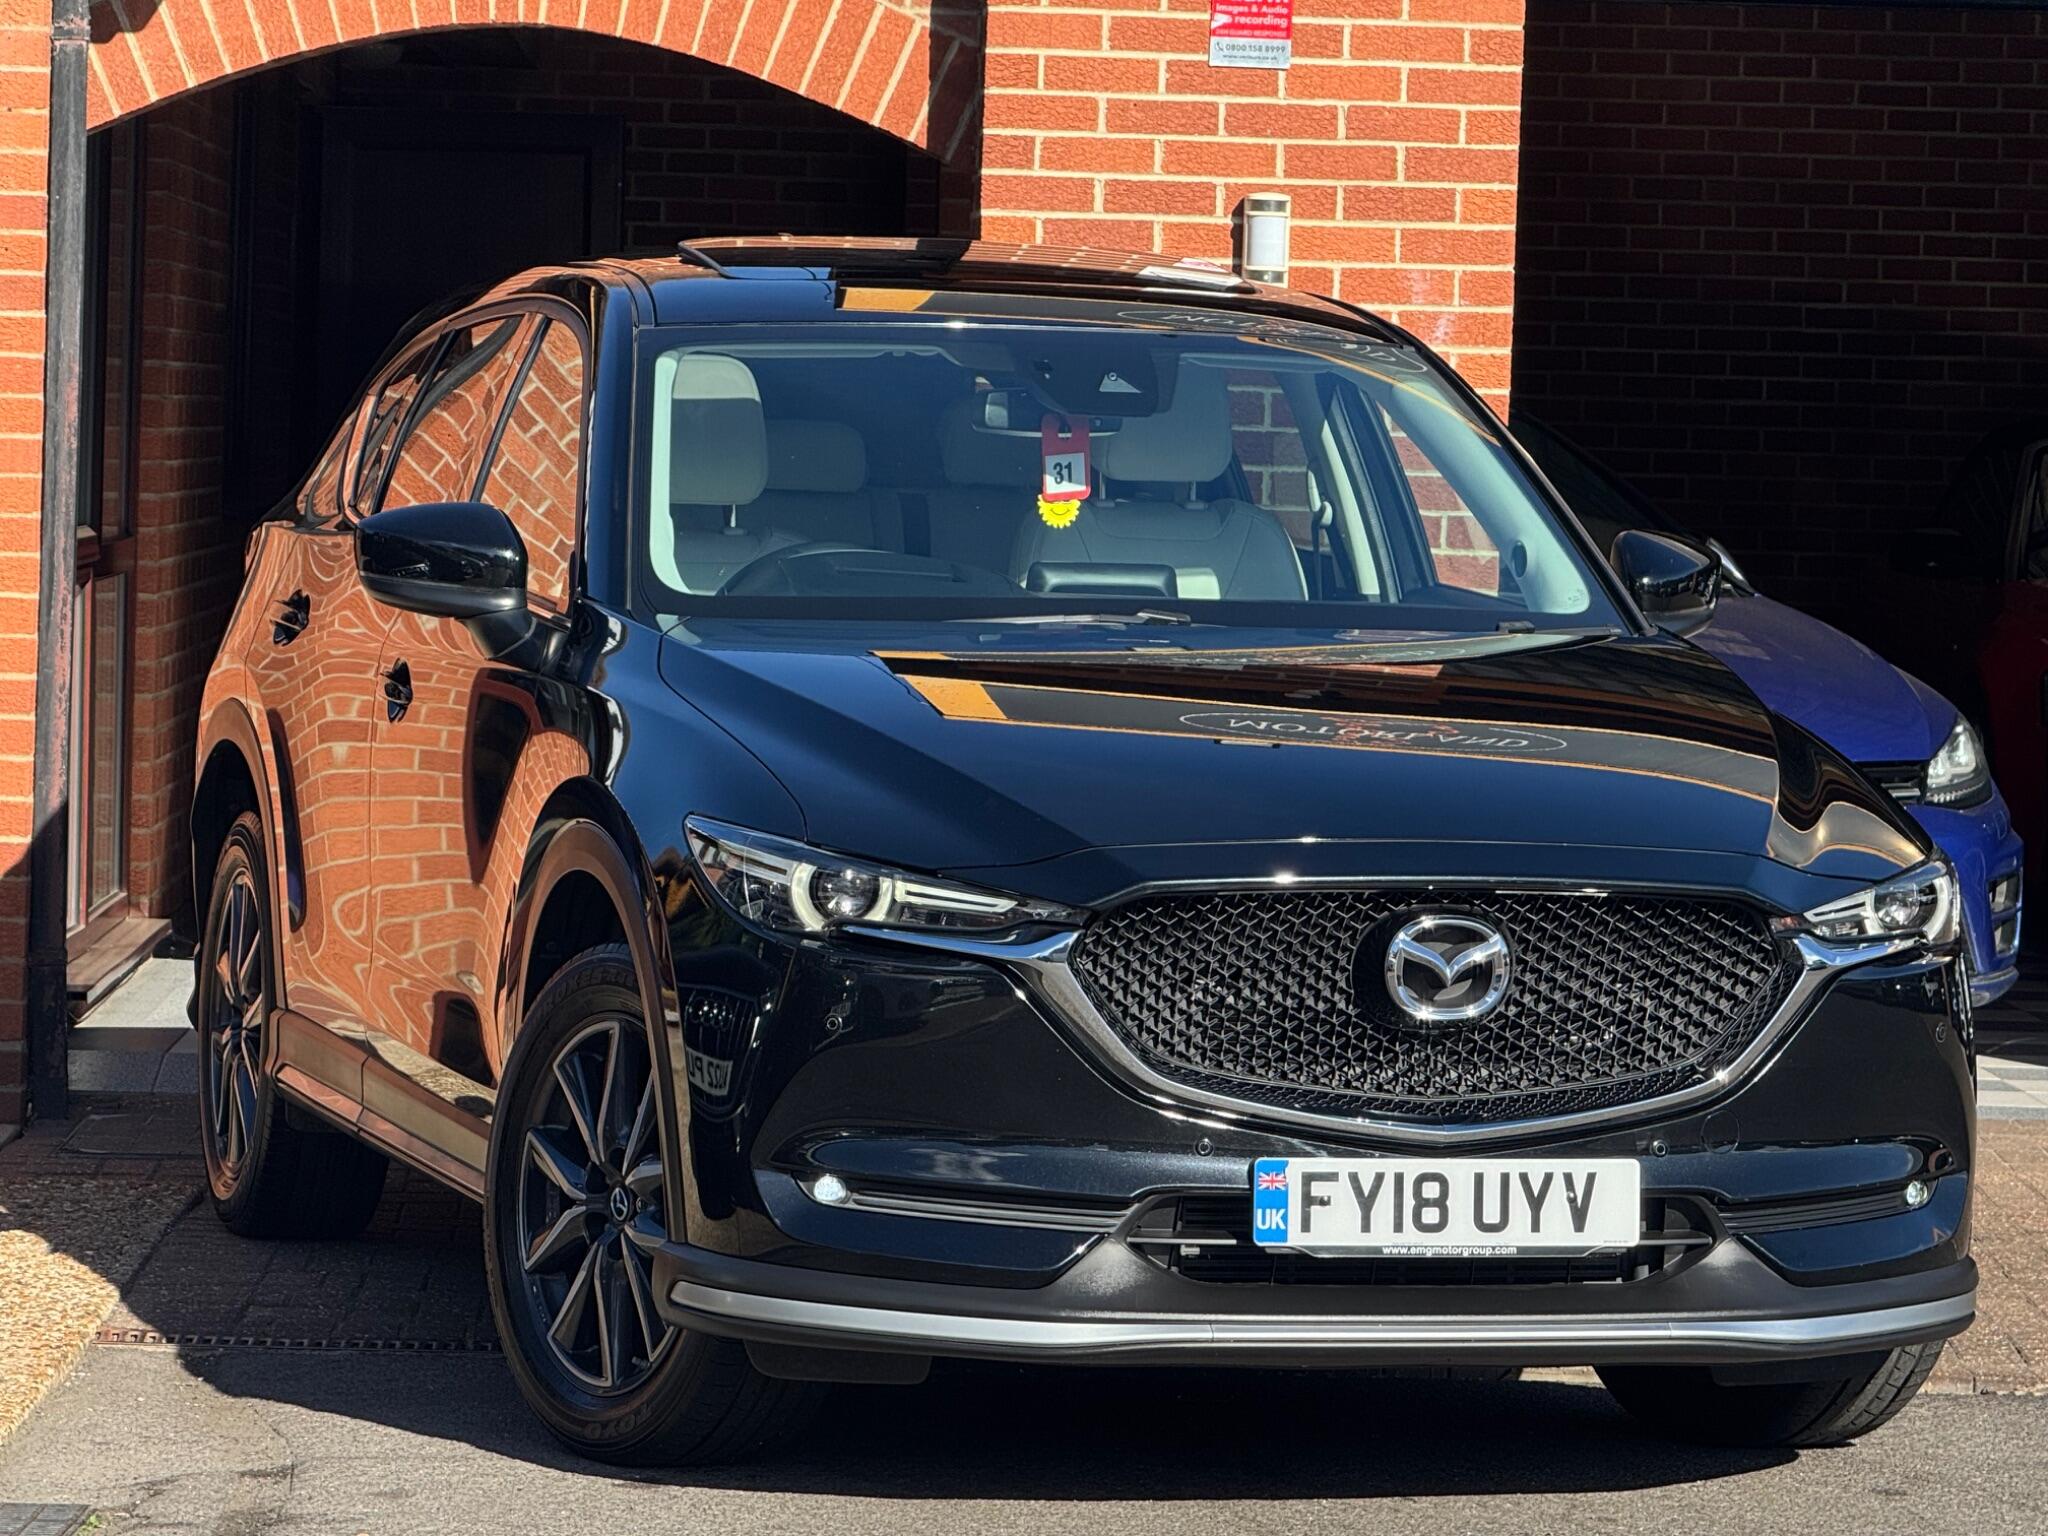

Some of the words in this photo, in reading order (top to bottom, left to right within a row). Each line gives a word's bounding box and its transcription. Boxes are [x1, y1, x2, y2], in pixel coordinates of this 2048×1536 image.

[1216, 3, 1248, 14] Images
[1250, 4, 1258, 13] &
[1261, 4, 1288, 15] Audio
[1234, 15, 1288, 28] recording
[1053, 461, 1073, 485] 31
[1300, 1171, 1450, 1234] FY18
[1472, 1171, 1598, 1234] UYV
[1256, 1207, 1286, 1231] UK
[1382, 1245, 1518, 1257] www.emgmotorgroup.com
